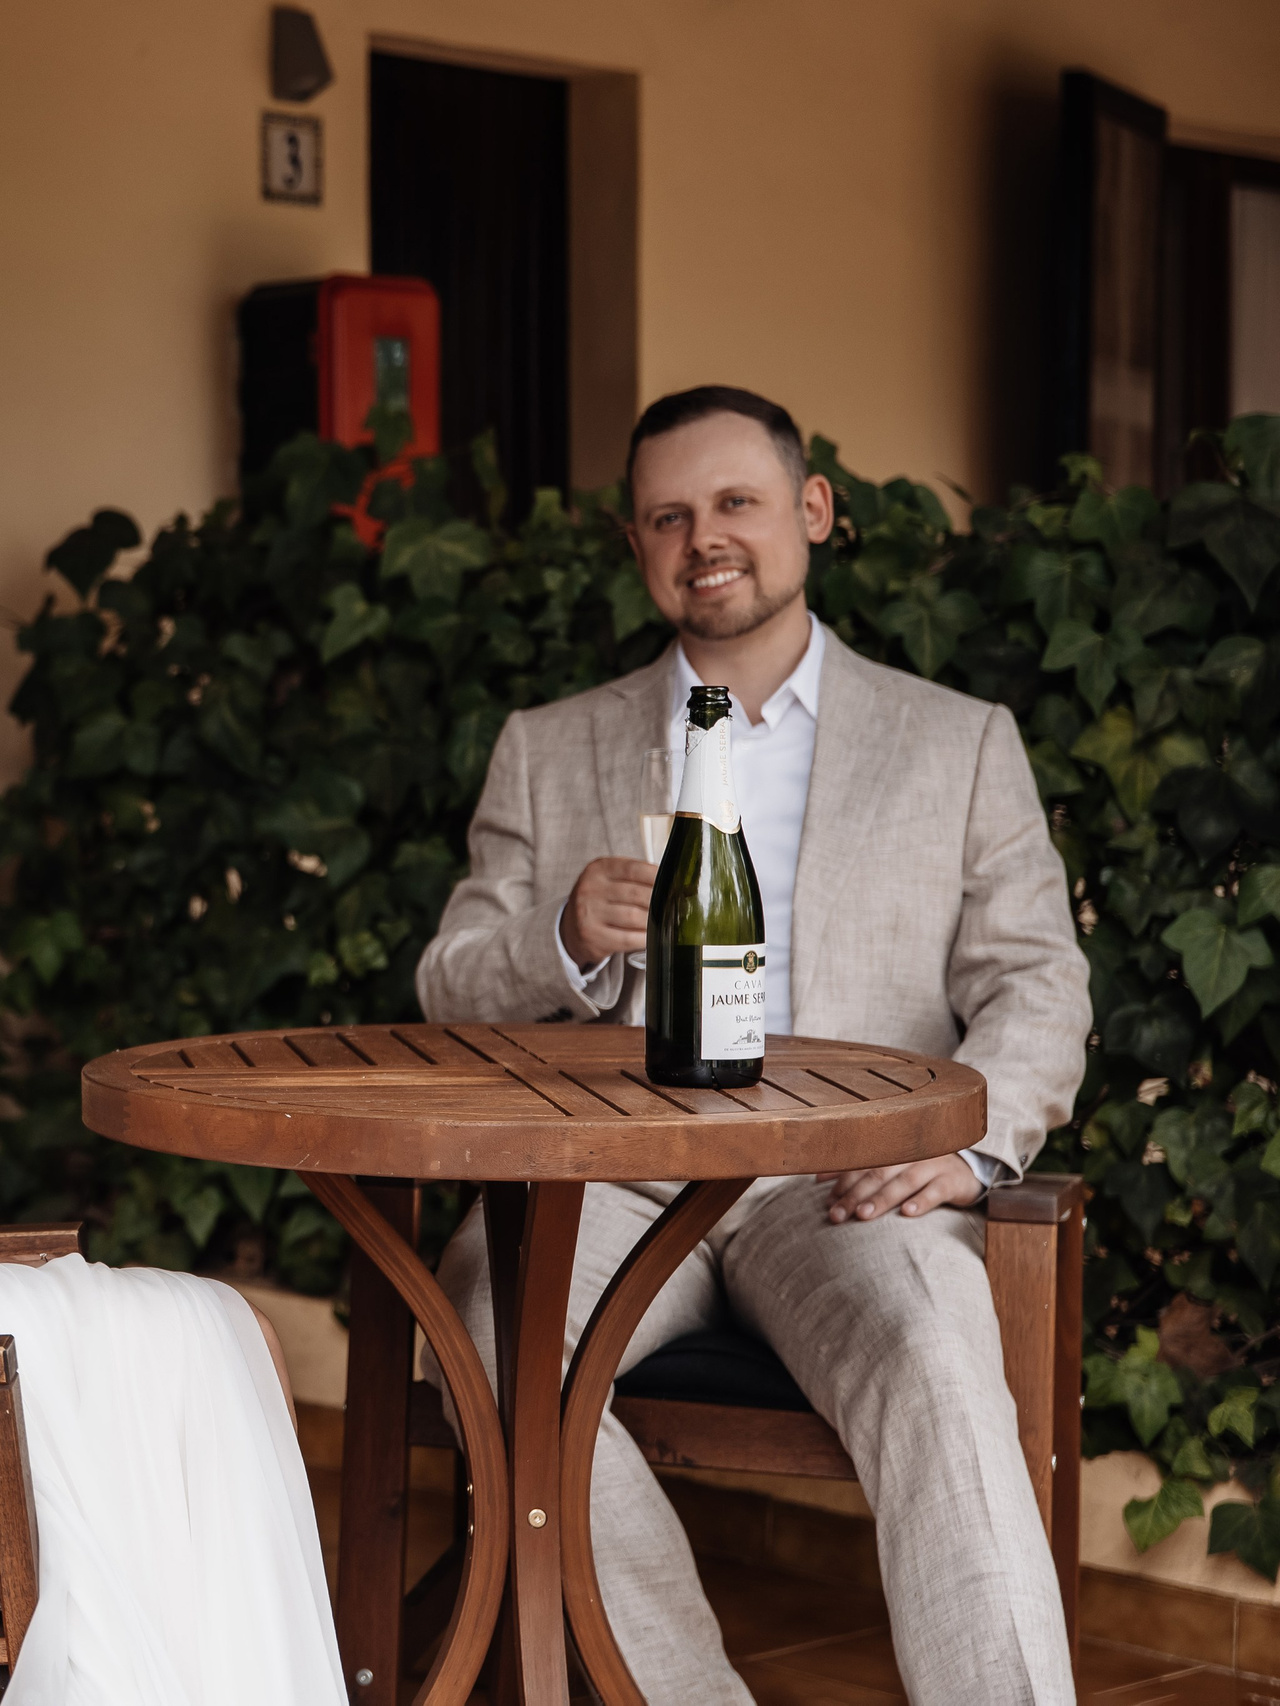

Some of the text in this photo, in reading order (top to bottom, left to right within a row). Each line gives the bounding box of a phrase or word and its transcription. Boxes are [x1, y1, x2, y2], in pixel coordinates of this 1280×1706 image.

[281, 131, 303, 191] 3
[734, 979, 762, 990] CAVA
[710, 993, 750, 1008] JAUME
